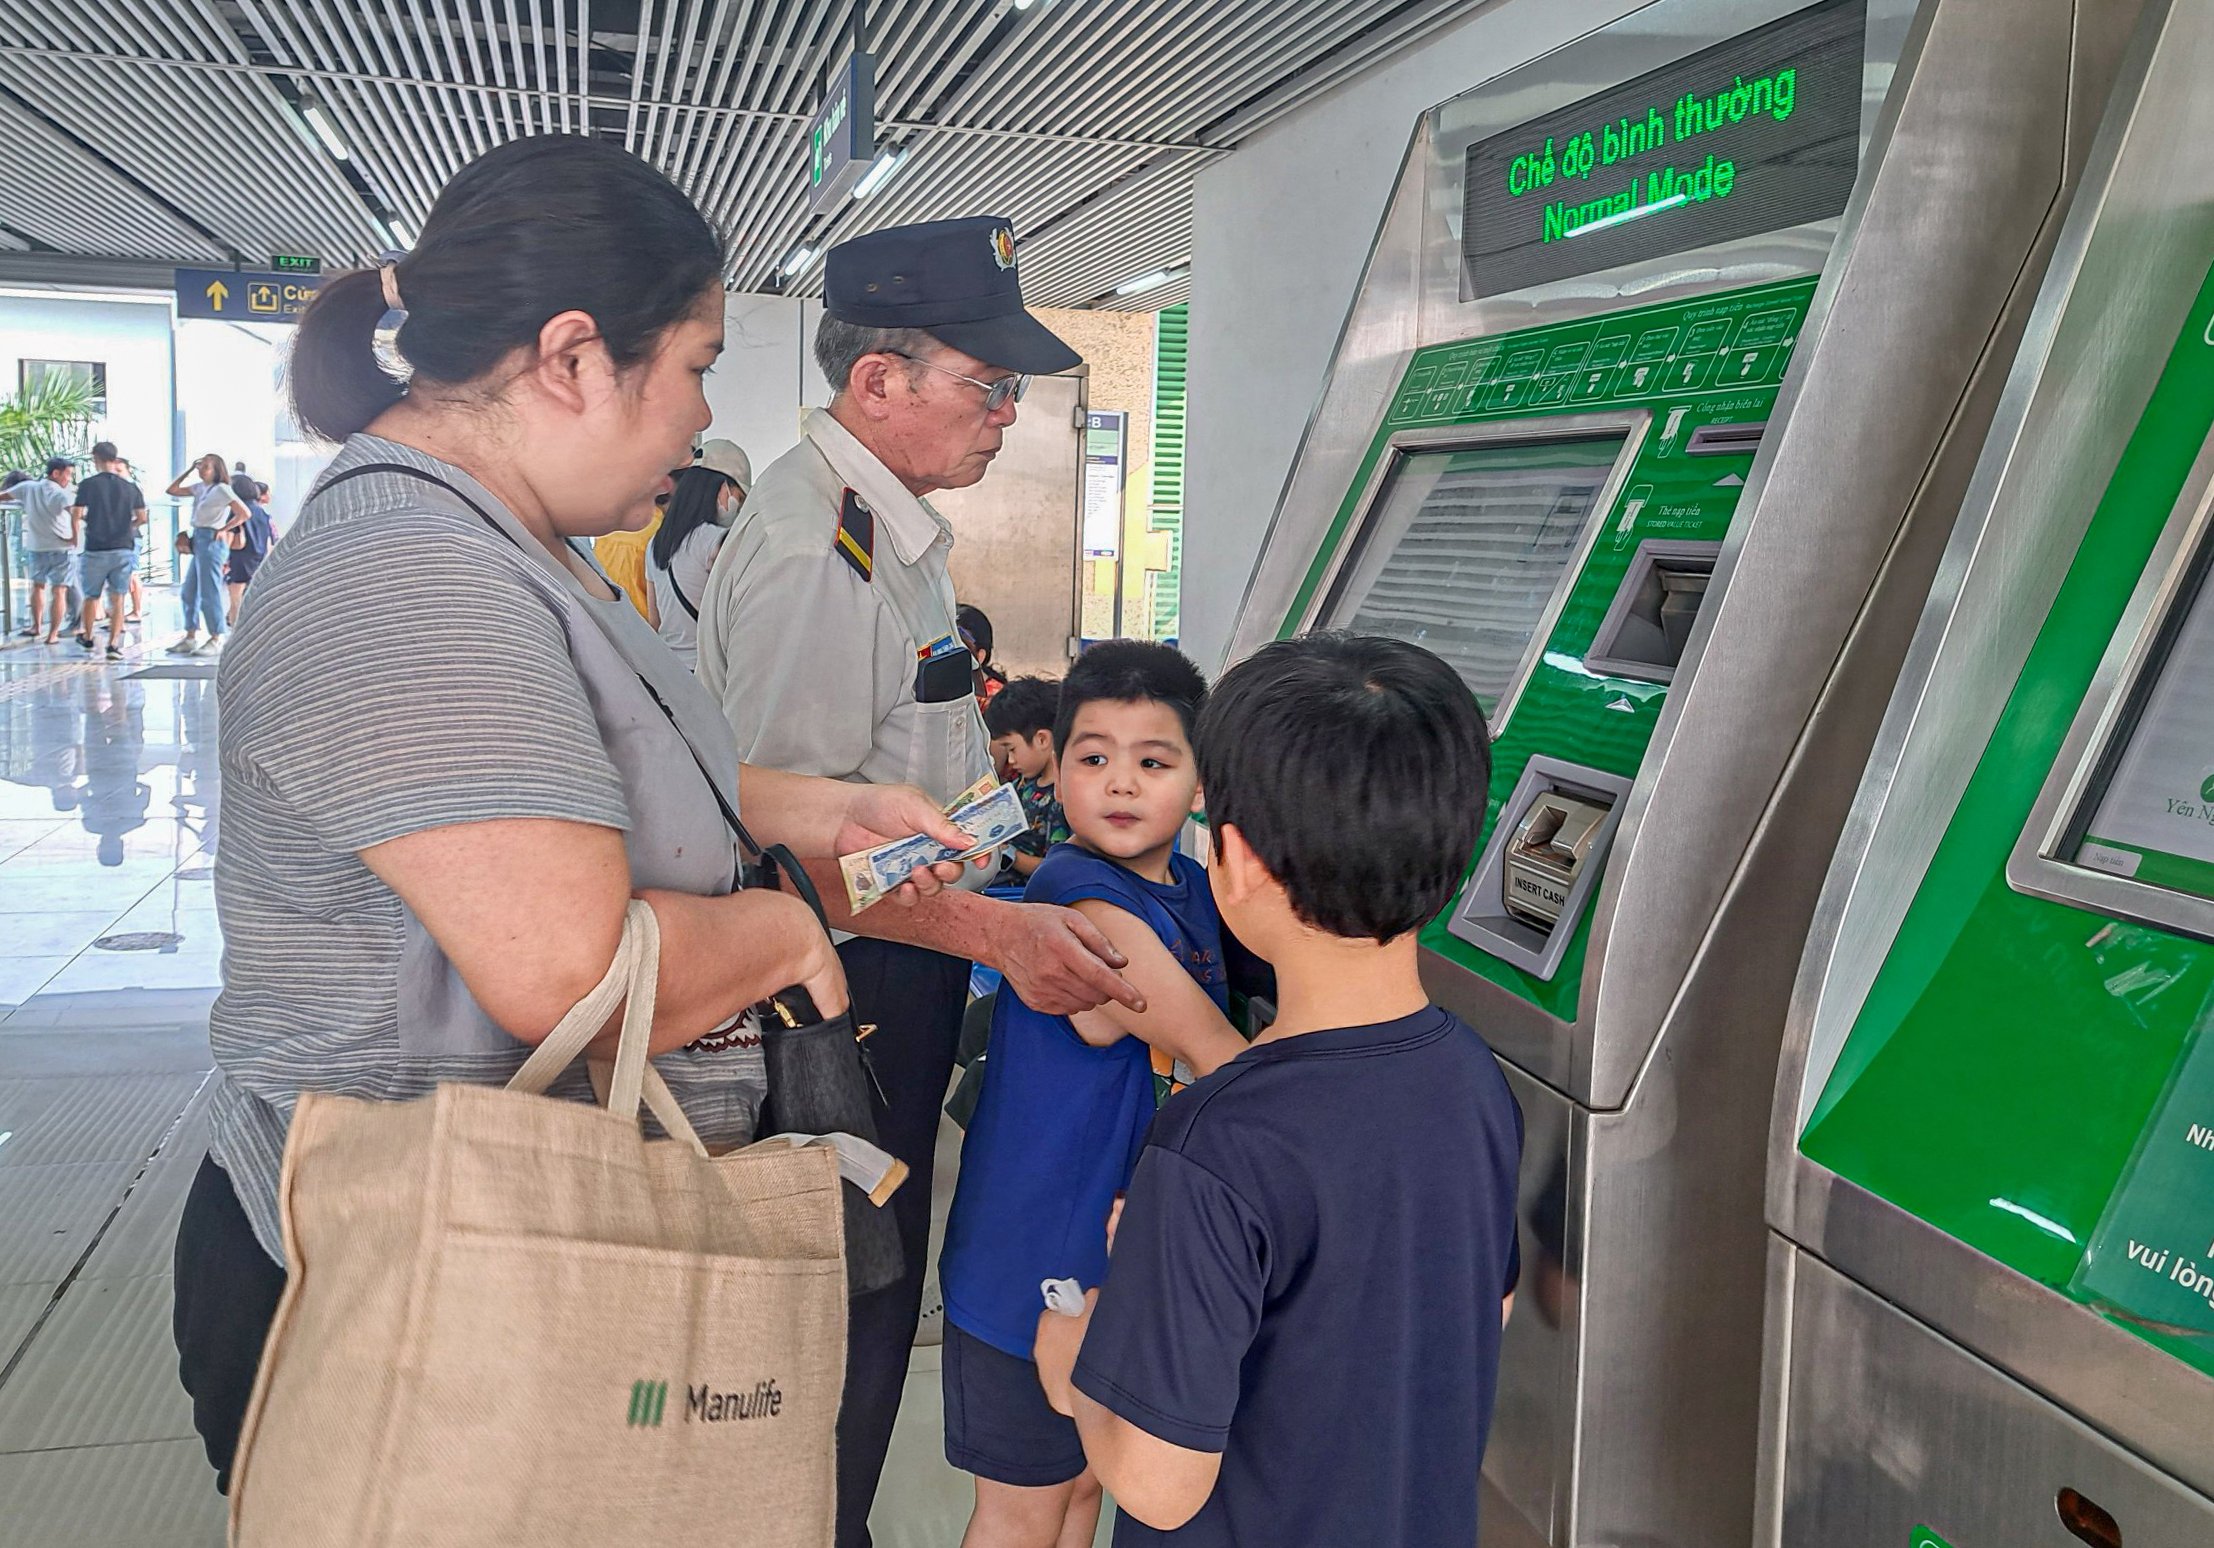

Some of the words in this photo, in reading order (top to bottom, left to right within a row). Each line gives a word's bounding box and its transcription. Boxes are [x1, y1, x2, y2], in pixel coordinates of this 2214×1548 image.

[1508, 138, 1556, 196] Chế
[1562, 131, 1595, 179] độ
[1602, 106, 1666, 166] bình
[1673, 67, 1798, 143] thường
[1543, 178, 1640, 244] Normal
[1645, 154, 1737, 209] Mode
[279, 255, 312, 267] EXIT
[2167, 798, 2195, 818] Yên
[1515, 877, 1542, 897] INSERT
[1543, 889, 1565, 907] CASH
[2127, 1238, 2170, 1274] vui
[2169, 1256, 2214, 1309] lòn
[684, 1378, 783, 1425] Manulife
